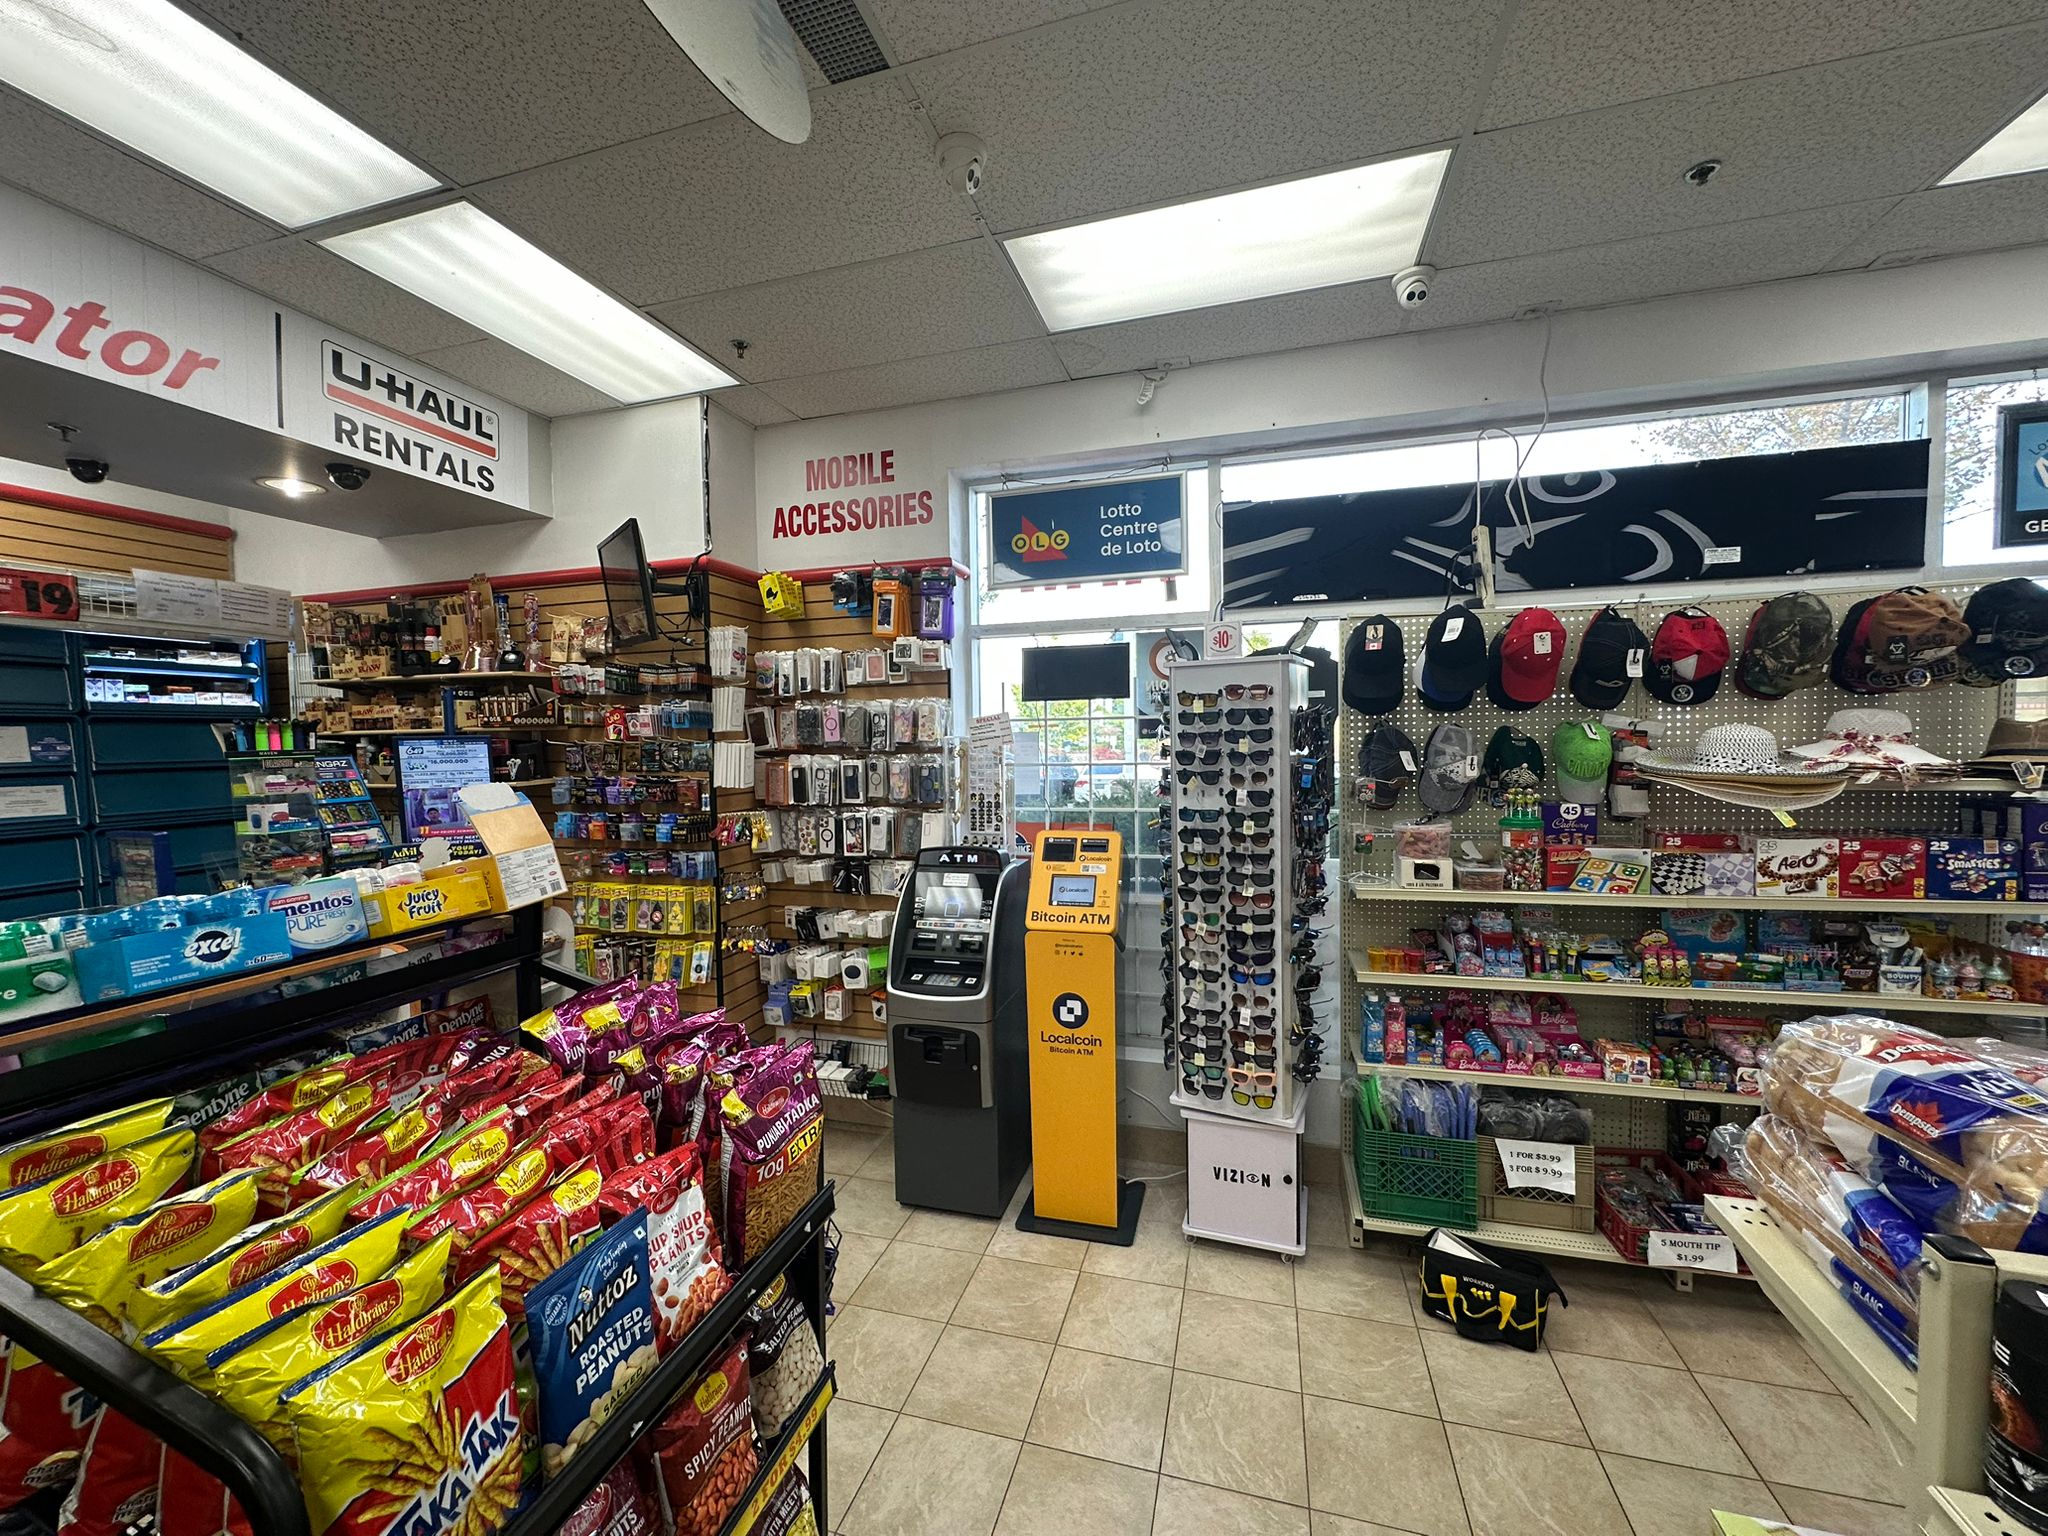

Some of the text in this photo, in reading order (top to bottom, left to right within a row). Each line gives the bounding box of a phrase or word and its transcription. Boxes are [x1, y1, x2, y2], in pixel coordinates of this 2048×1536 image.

[334, 412, 495, 492] RENTALS
[806, 450, 895, 492] MOBILE
[773, 490, 934, 539] ACCESSORIES
[1100, 503, 1142, 519] Lotto
[1100, 521, 1158, 538] Centre
[1013, 532, 1068, 551] OLG
[1100, 540, 1162, 557] de Loto
[20, 580, 74, 615] 19
[357, 663, 382, 673] RAW
[607, 713, 621, 723] UNO
[976, 714, 1001, 724] SPECIAL
[1562, 806, 1579, 816] 45
[1551, 818, 1589, 831] Cadbury
[1665, 837, 1682, 846] 25
[1759, 841, 1778, 851] 25
[1842, 841, 1861, 850] 25
[1929, 841, 1950, 851] 25
[939, 854, 978, 863] ATM
[404, 887, 440, 908] Juicy
[408, 900, 443, 920] Fruit
[1031, 910, 1111, 925] Bitcoin ATM
[287, 909, 347, 934] PURE FRESH
[183, 926, 242, 959] excel
[1886, 973, 1921, 981] BOUNTY
[439, 1001, 484, 1034] Dentyne
[1540, 1012, 1569, 1026] Barbie
[1040, 1030, 1102, 1048] Localcoin
[1049, 1046, 1094, 1056] Bitcoin ATM
[1459, 1058, 1483, 1071] Barbie
[1506, 1059, 1529, 1072] Barbie
[1563, 1063, 1587, 1074] Barbie
[788, 1120, 824, 1162] EXTRA
[1516, 1151, 1534, 1160] FOR
[1535, 1153, 1561, 1163] $3.99
[756, 1156, 785, 1183] 10g
[1516, 1165, 1533, 1174] FOR
[1542, 1167, 1563, 1178] 9.99
[1897, 1155, 1941, 1188] BLANC
[63, 1172, 132, 1213] Haldiram's
[650, 1226, 705, 1273] PEANUTS
[1660, 1239, 1721, 1251] 5 MOUTH TIP
[1676, 1253, 1705, 1263] $1.99
[1462, 1275, 1495, 1290] WORKPRO
[1853, 1281, 1884, 1317] BLANC
[326, 1294, 396, 1347] Haldiram's
[579, 1306, 644, 1369] ROASTED
[764, 1320, 788, 1355] SALTED
[576, 1313, 653, 1396] PEANUTS
[603, 1365, 644, 1417] SALTED
[684, 1433, 717, 1481] SPICY
[718, 1394, 752, 1443] PEANUTS
[751, 1496, 760, 1518] 2
[761, 1453, 788, 1503] FOR
